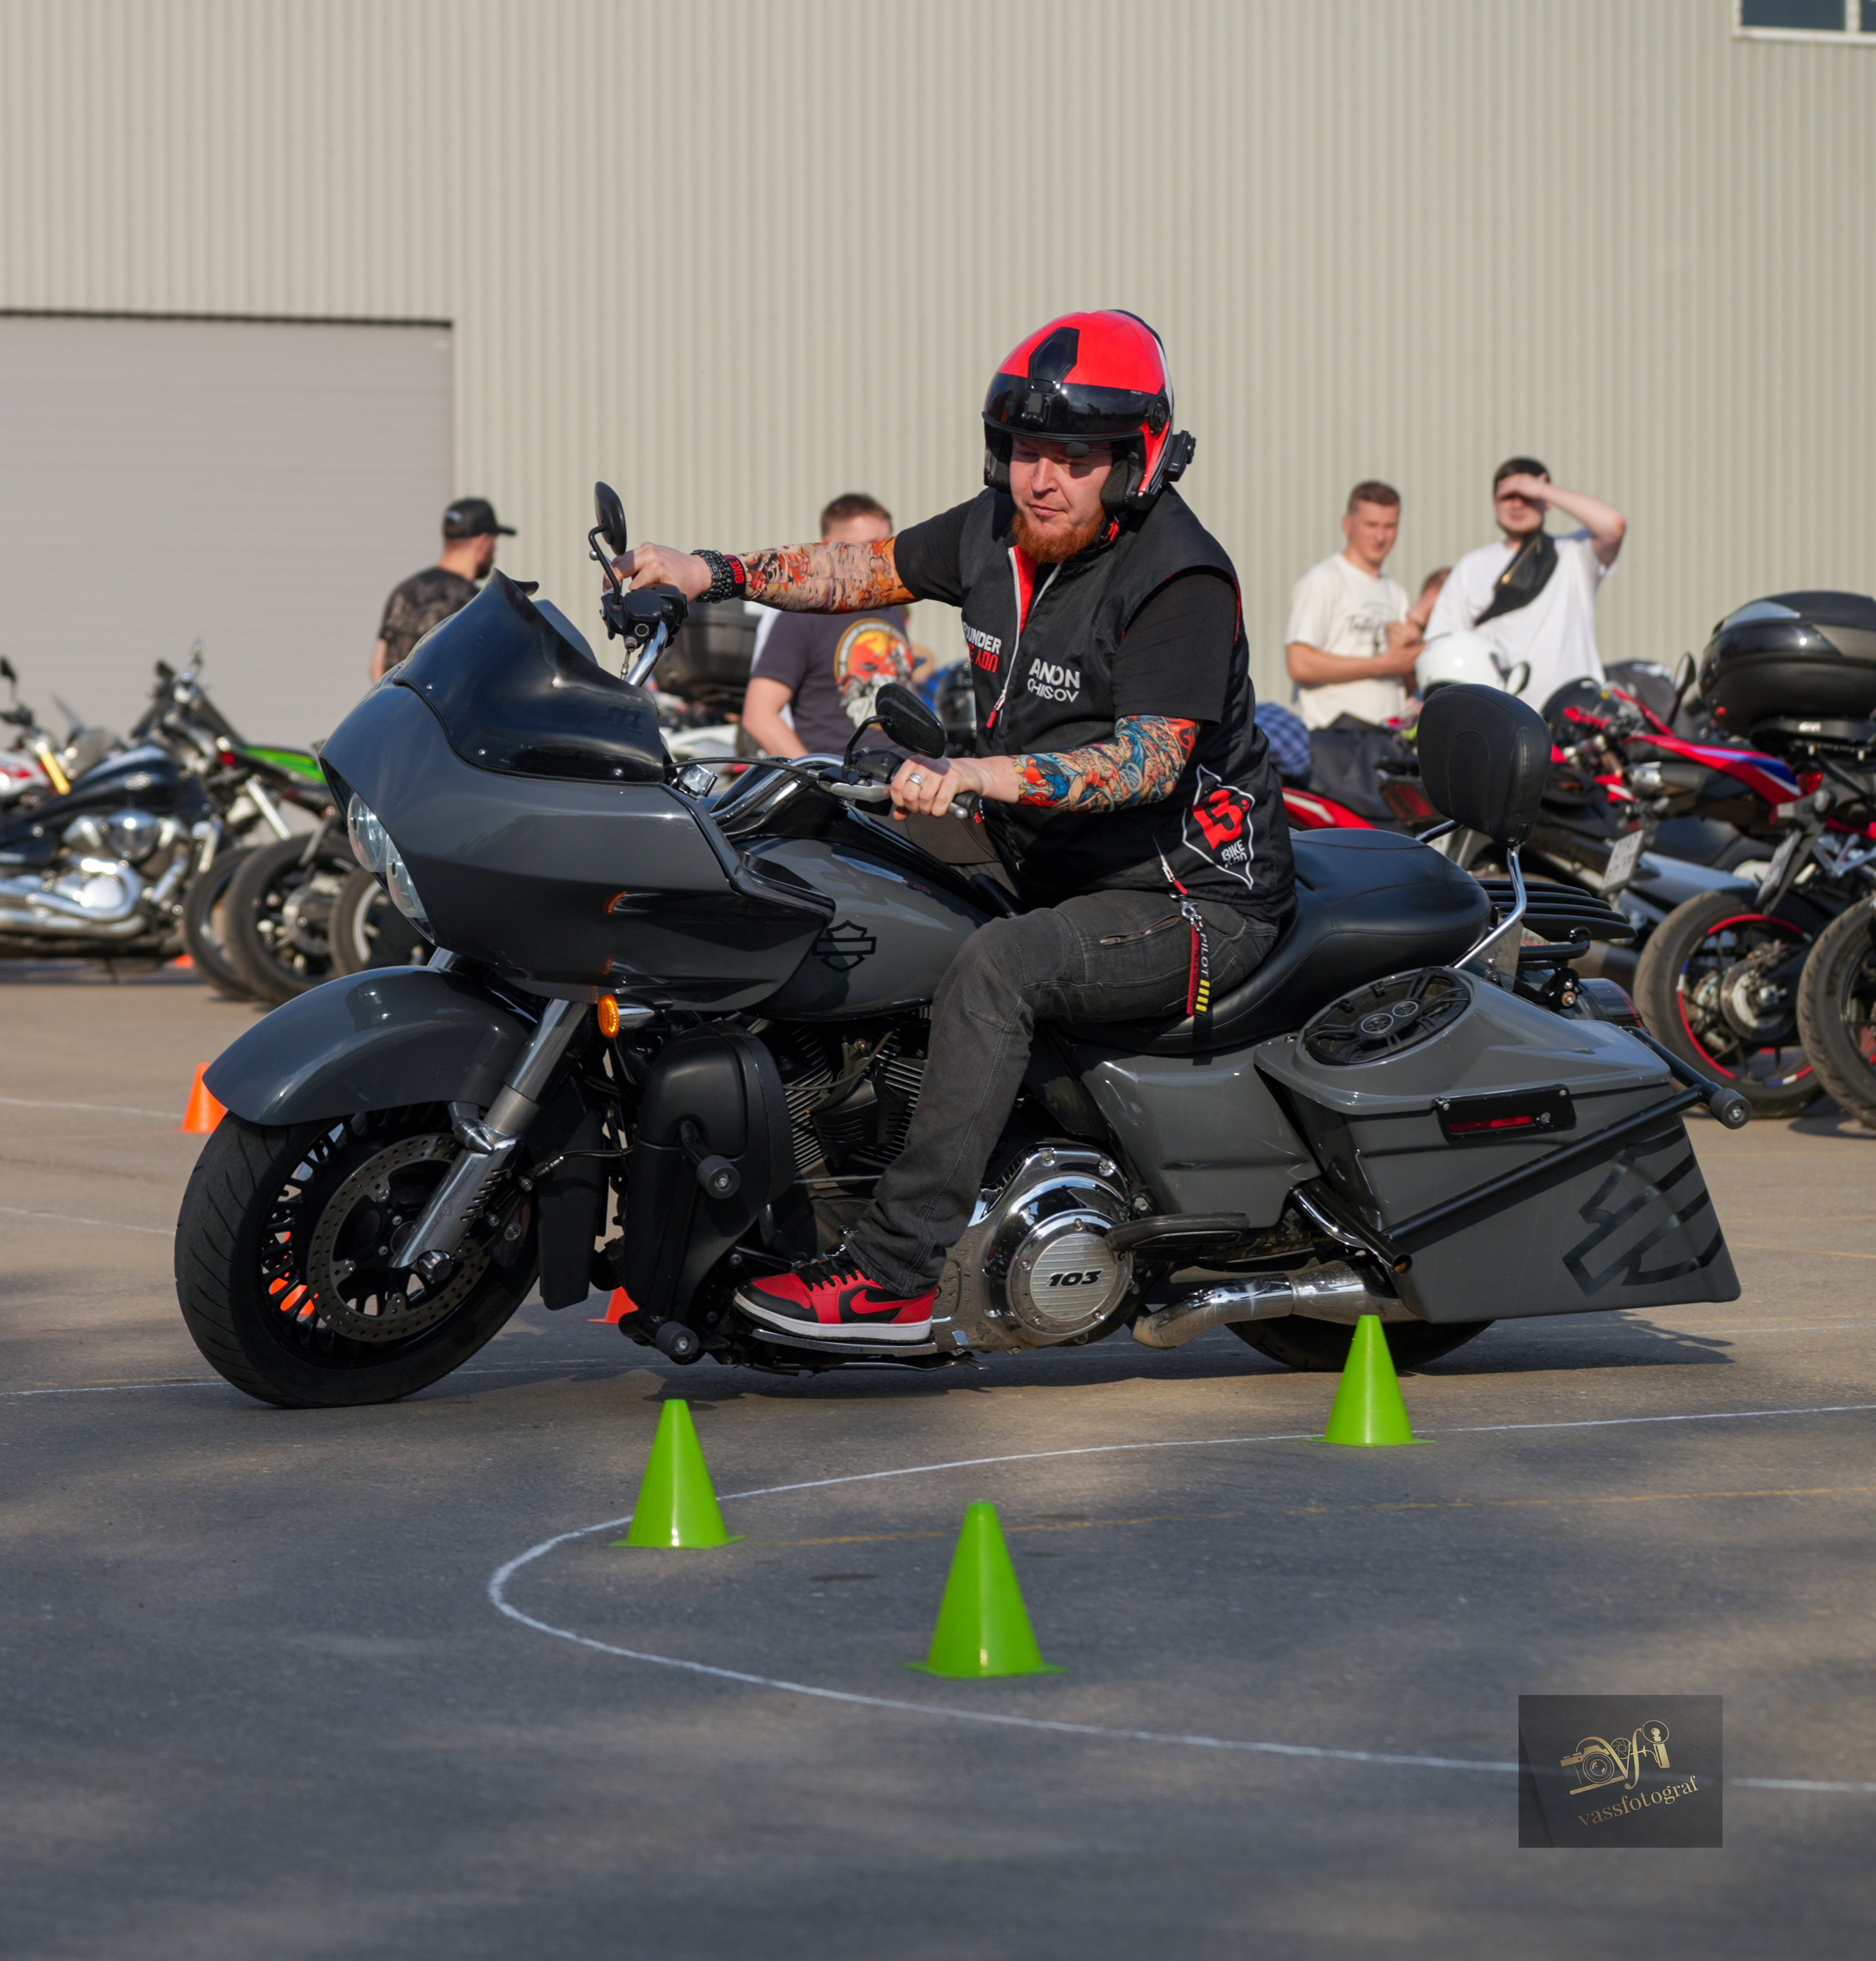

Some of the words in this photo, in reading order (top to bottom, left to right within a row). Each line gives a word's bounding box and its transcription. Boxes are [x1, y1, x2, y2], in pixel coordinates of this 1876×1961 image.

[729, 560, 745, 584] BIKE
[963, 621, 1002, 654] OUNDER
[1222, 839, 1245, 861] BIKE
[1200, 933, 1209, 978] PILOT
[1047, 1269, 1104, 1288] 103
